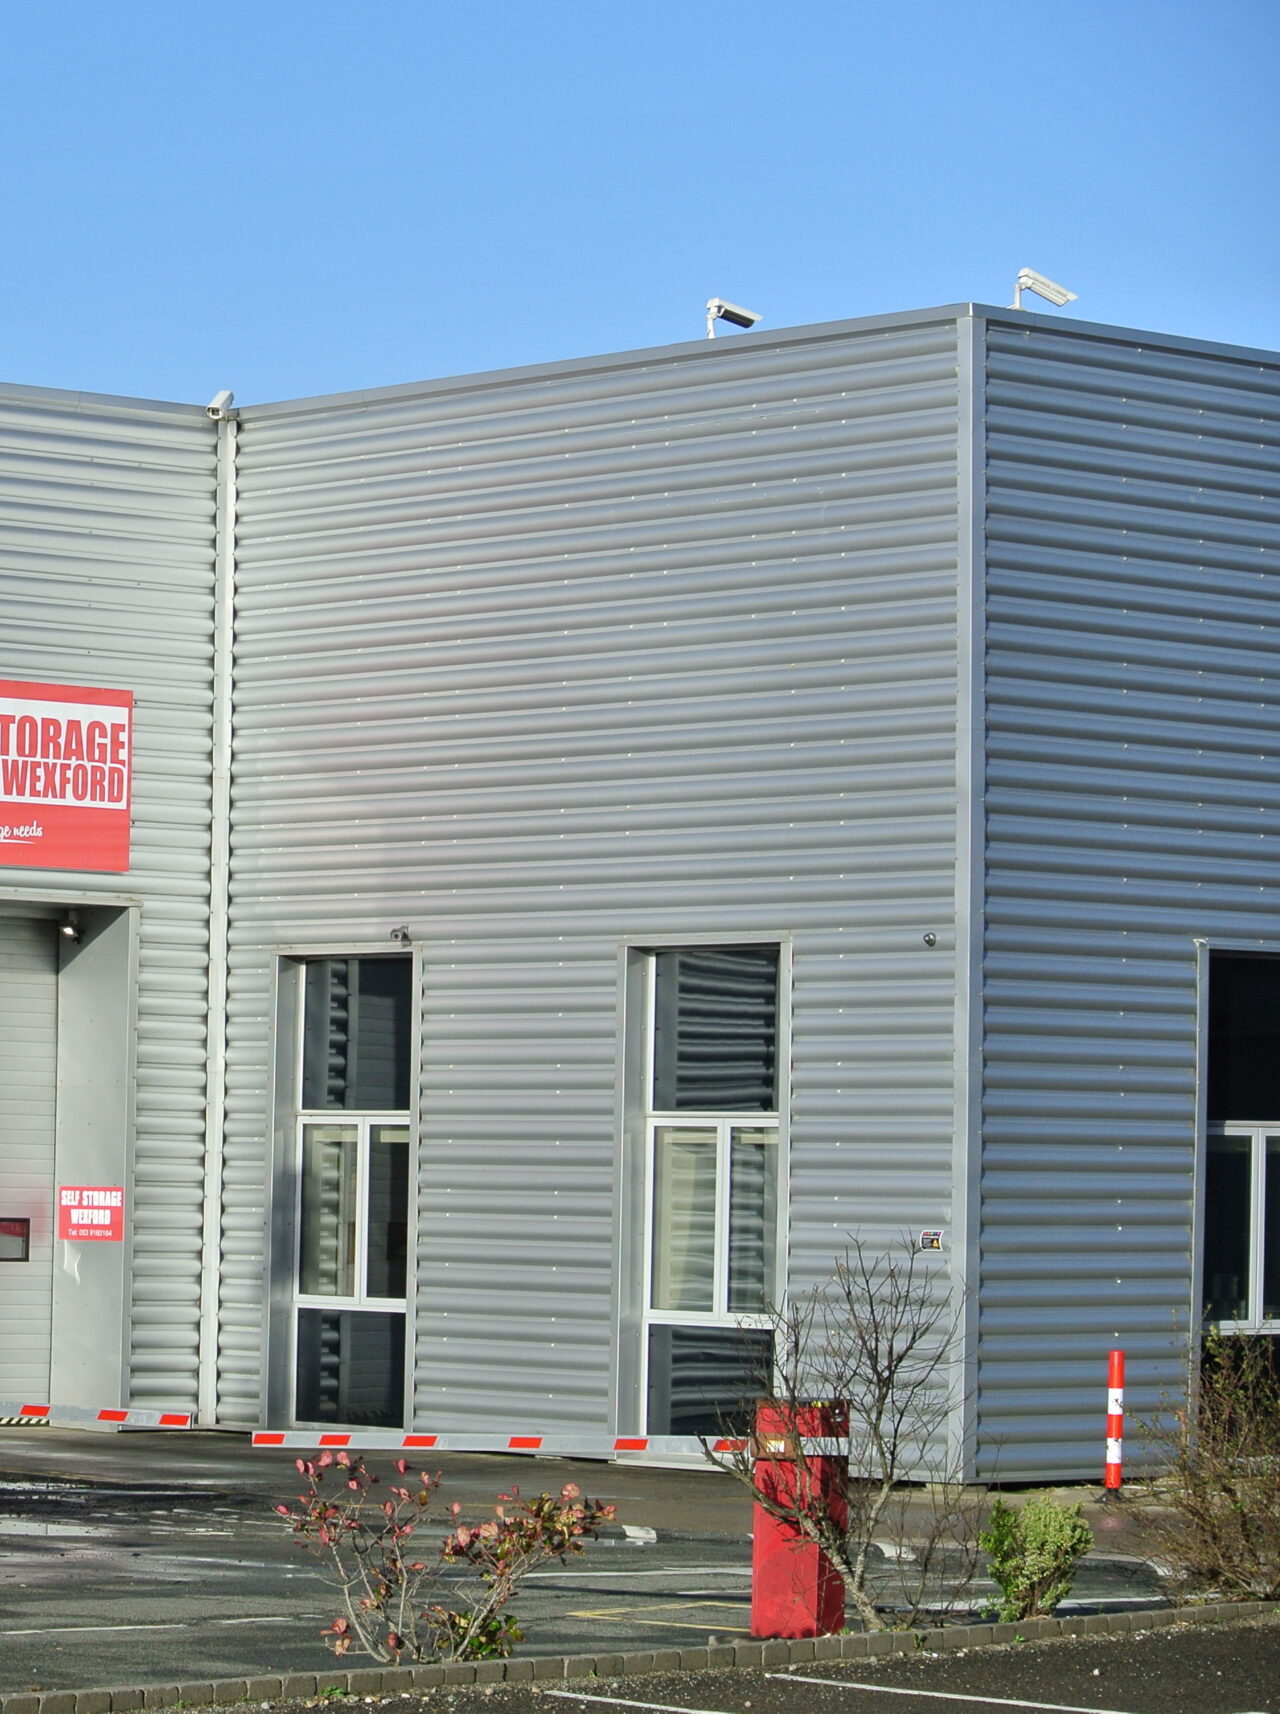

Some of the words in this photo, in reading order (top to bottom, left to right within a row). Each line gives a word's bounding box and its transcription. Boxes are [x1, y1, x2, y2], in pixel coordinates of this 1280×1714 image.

[1, 758, 124, 803] WEXFORD
[13, 820, 43, 837] needs
[61, 1190, 80, 1206] SELF
[82, 1190, 122, 1207] STORAGE
[70, 1208, 111, 1225] WEXFORD
